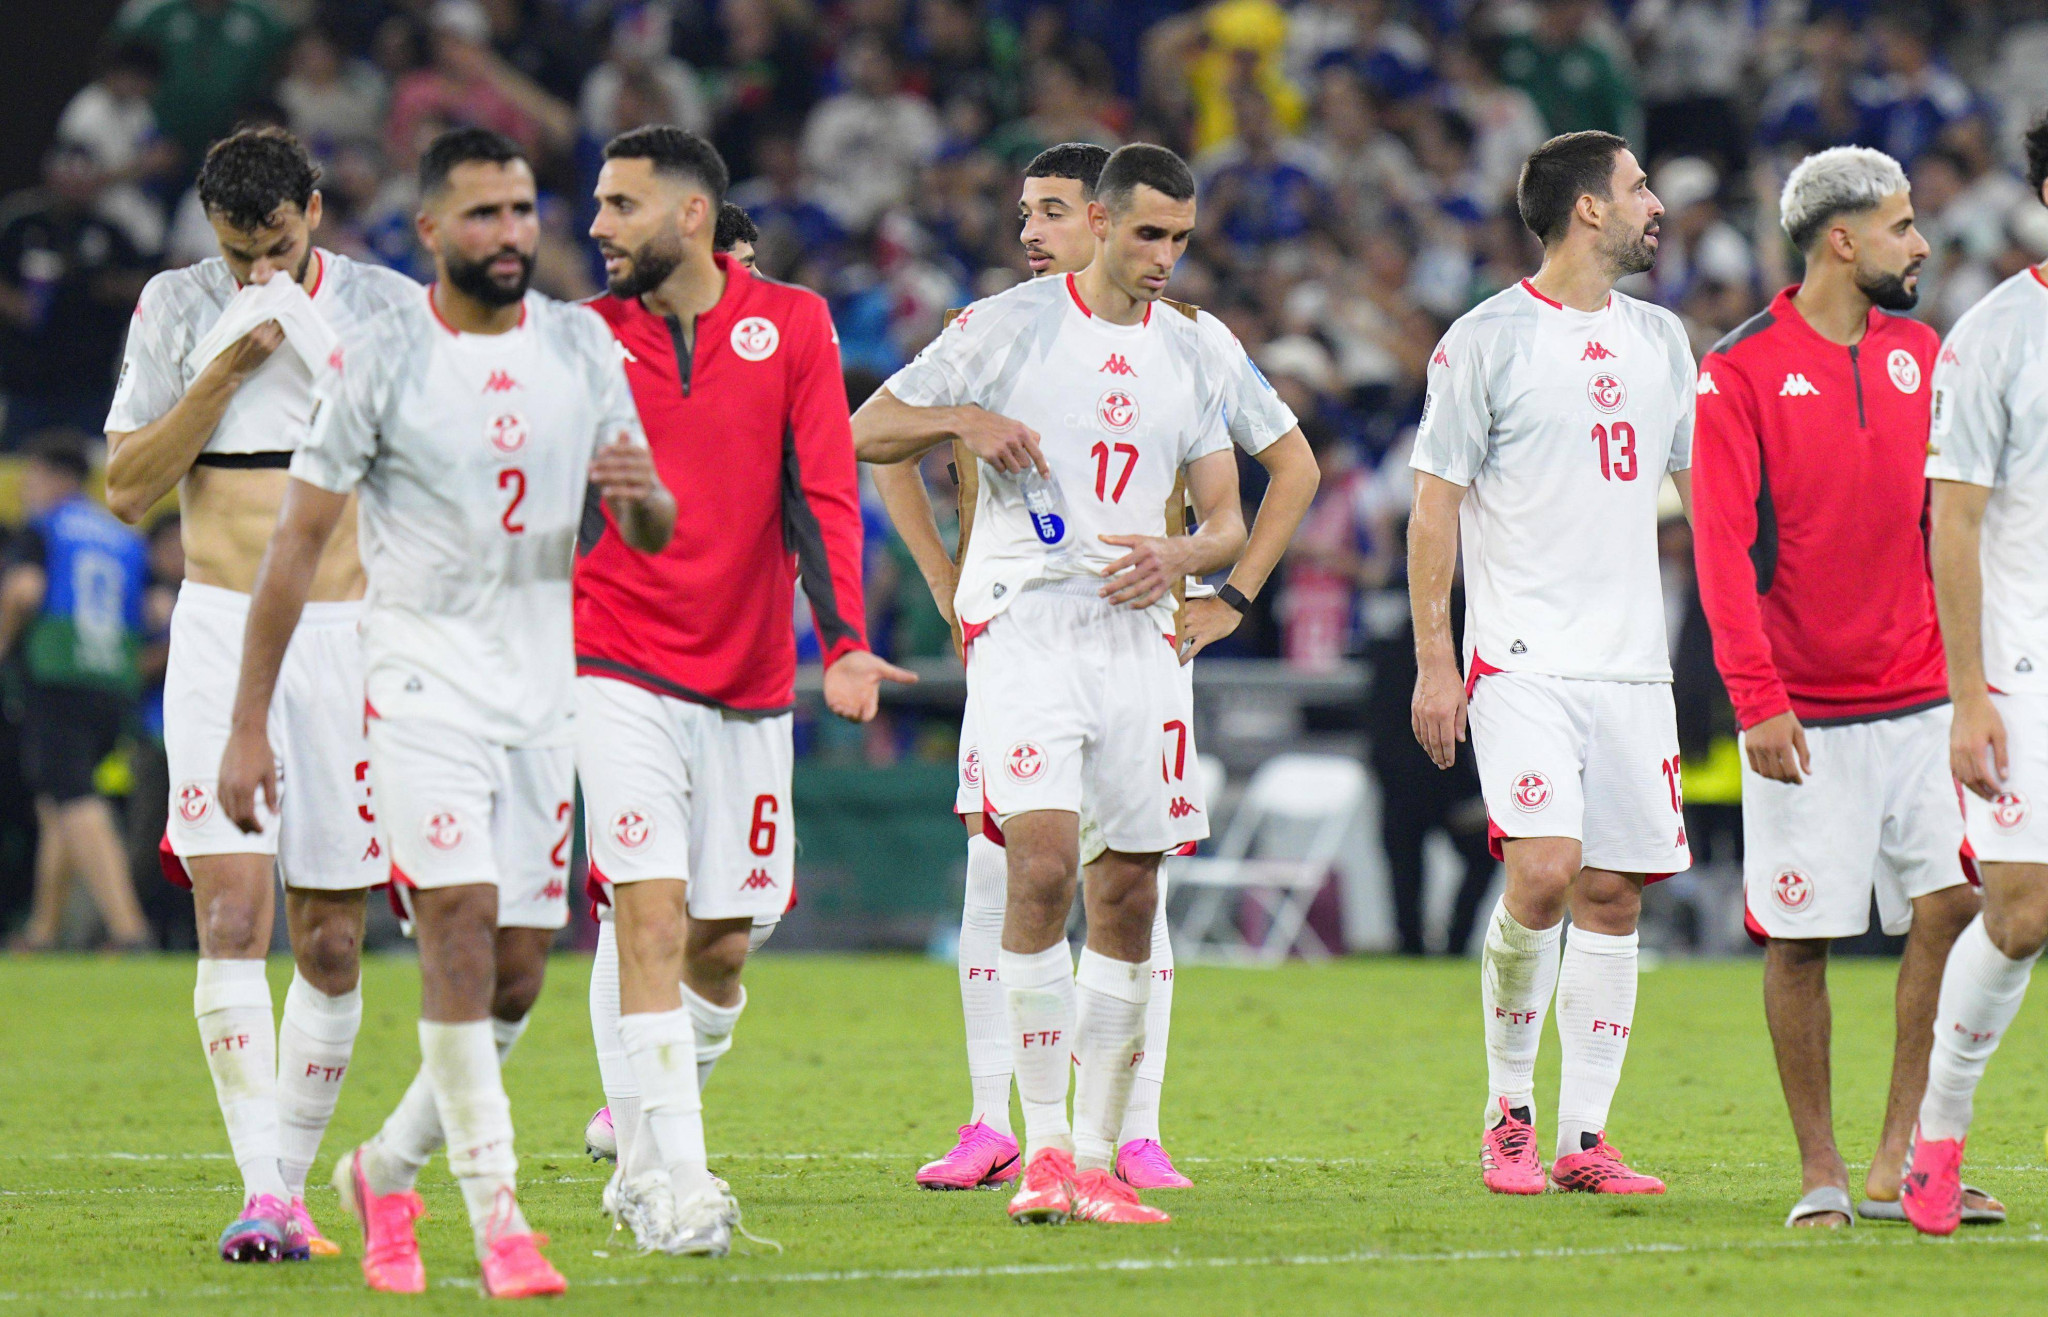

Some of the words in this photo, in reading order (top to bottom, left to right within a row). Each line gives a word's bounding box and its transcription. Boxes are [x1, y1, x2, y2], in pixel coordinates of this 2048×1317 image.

[1091, 440, 1139, 504] 17
[1591, 421, 1638, 481] 13
[498, 467, 526, 534] 2
[1027, 489, 1056, 538] smart
[1162, 719, 1186, 785] 7
[551, 801, 574, 867] 2
[749, 794, 778, 857] 6
[969, 967, 999, 981] FT
[1023, 1030, 1062, 1049] FTF
[1495, 1007, 1537, 1025] FTF
[1592, 1020, 1630, 1039] FTF
[209, 1034, 249, 1056] FTF
[306, 1062, 346, 1083] FTF
